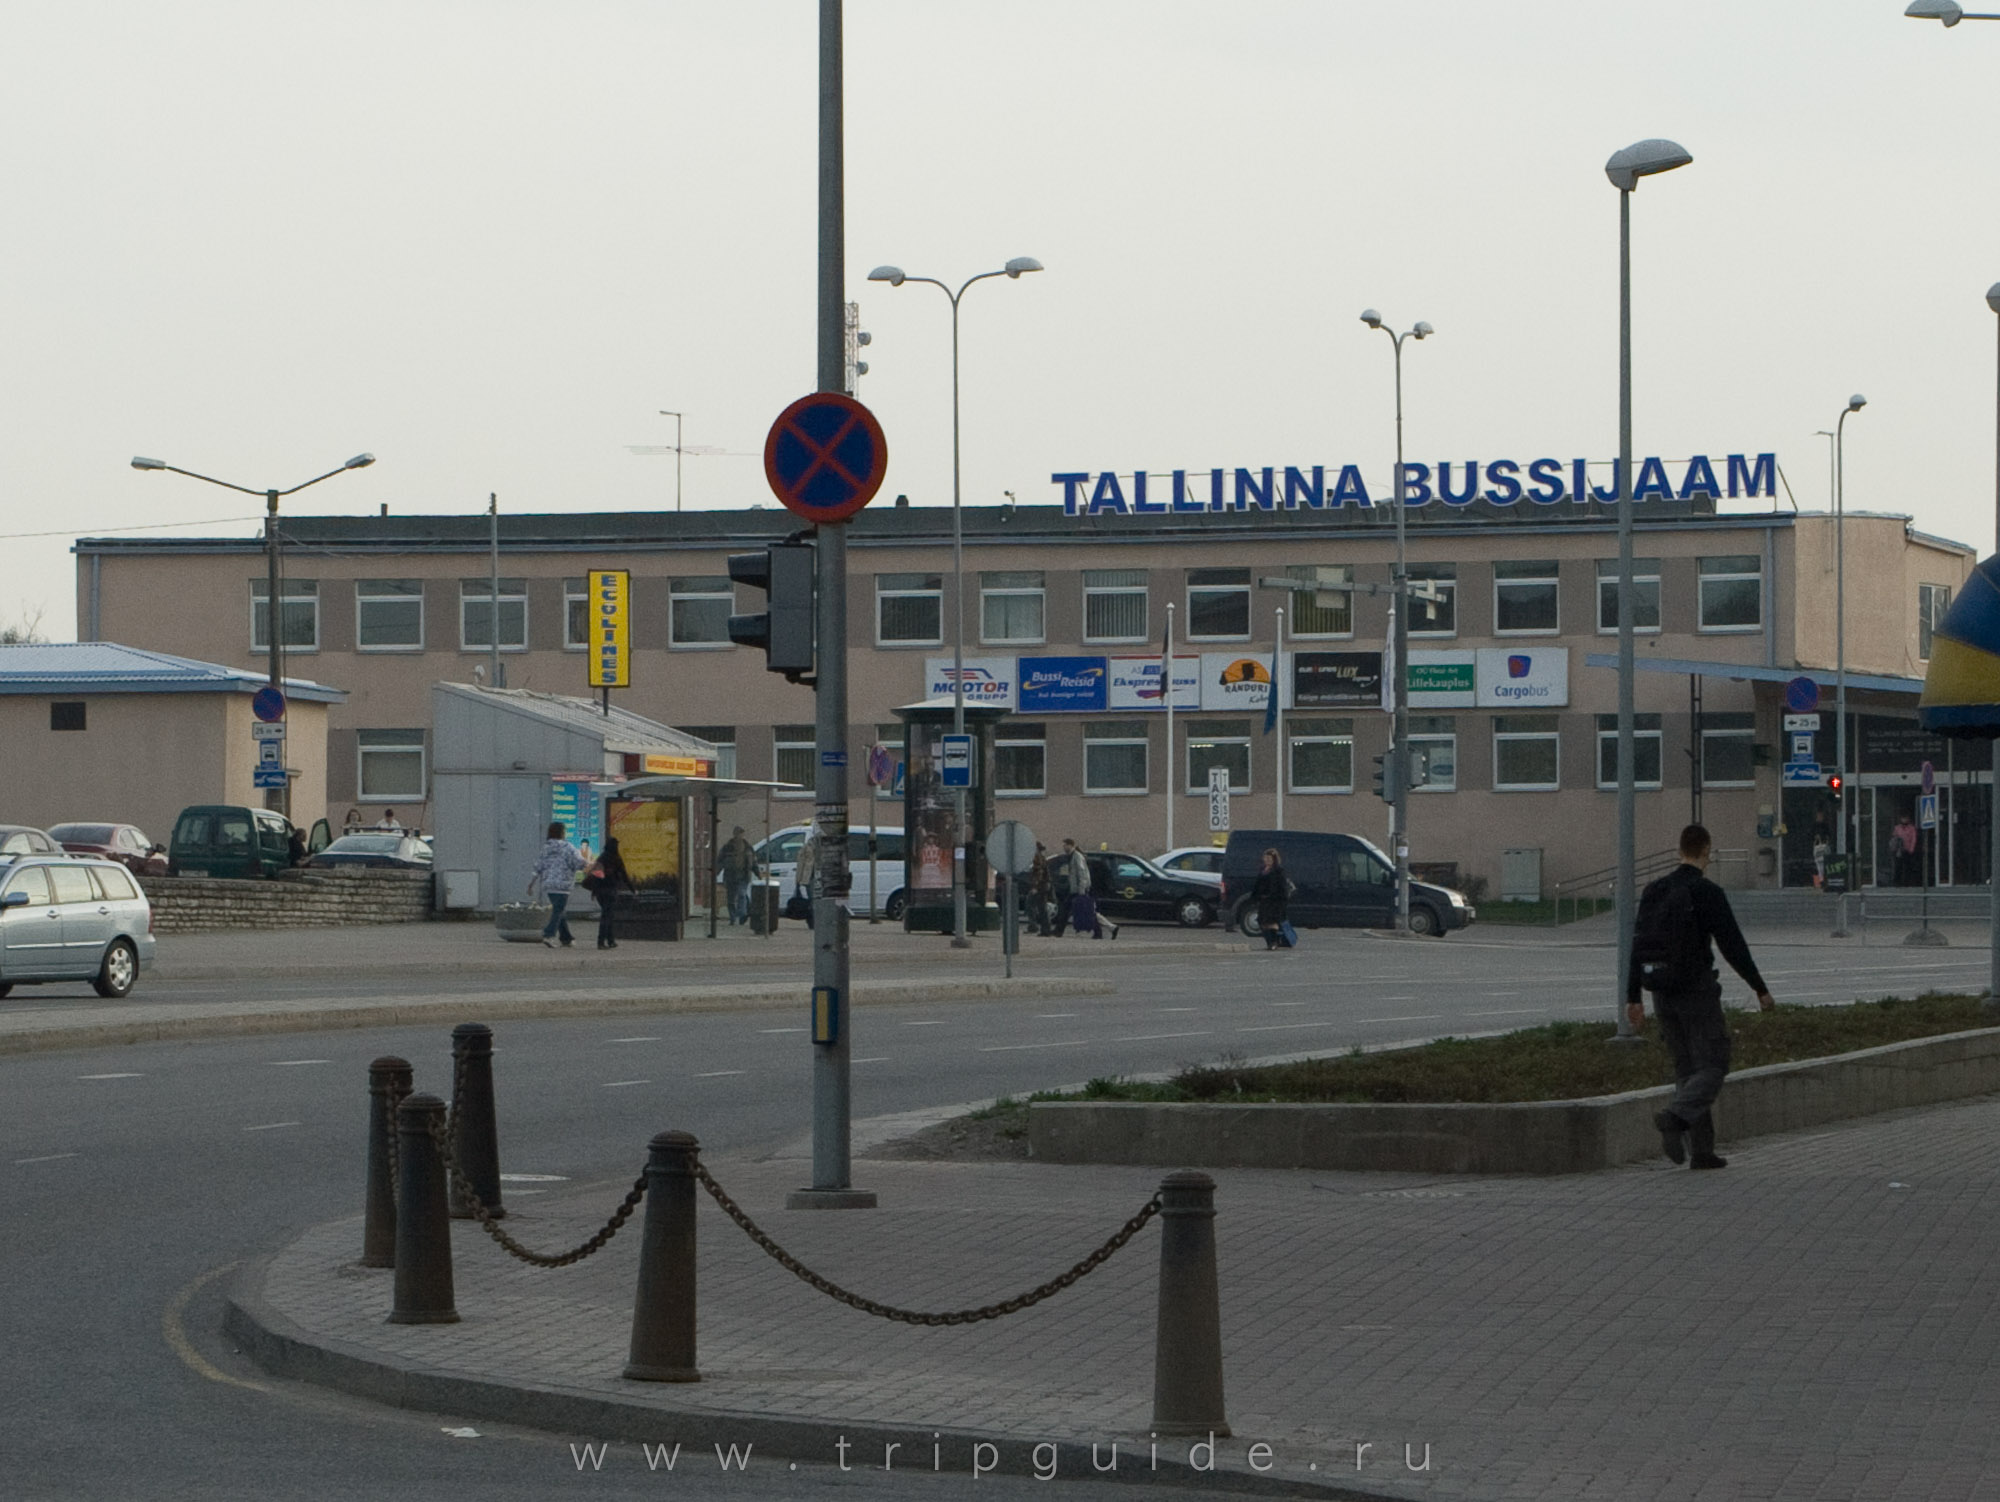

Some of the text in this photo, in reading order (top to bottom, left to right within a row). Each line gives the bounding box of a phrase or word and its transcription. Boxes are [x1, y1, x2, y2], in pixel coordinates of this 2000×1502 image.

[1051, 453, 1776, 516] TALLINNA BUSSIJAAM
[601, 574, 617, 683] ECOLINES
[1032, 671, 1095, 687] Bussi Reisid
[1337, 665, 1359, 678] LUX
[1406, 677, 1470, 690] Lillekauplus
[966, 693, 1008, 701] GRUPP
[1494, 684, 1549, 699] Cargobus
[1799, 718, 1809, 727] 25
[1211, 773, 1220, 826] TAKSO
